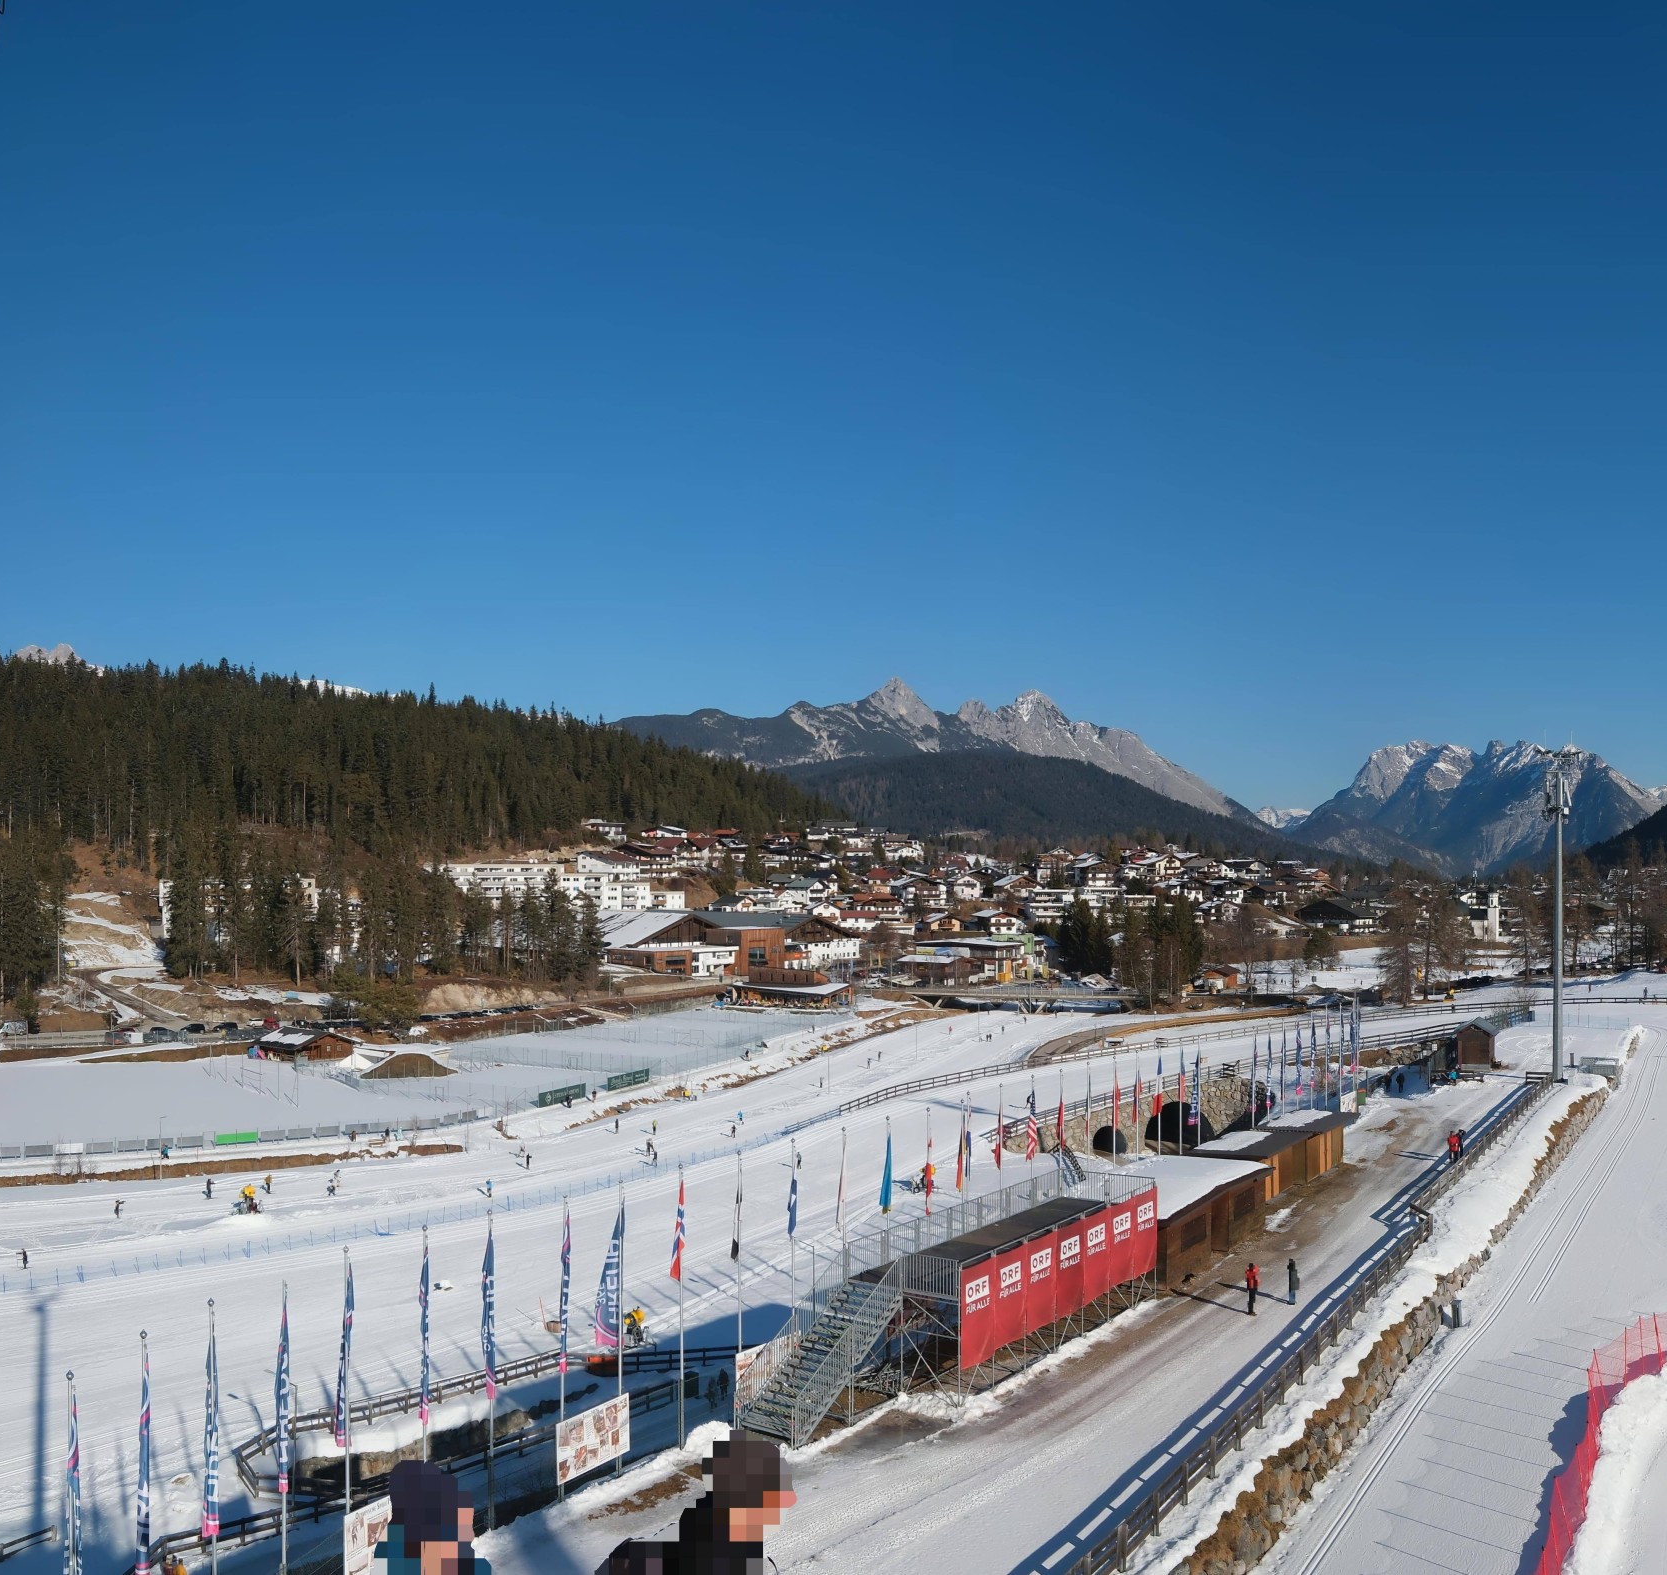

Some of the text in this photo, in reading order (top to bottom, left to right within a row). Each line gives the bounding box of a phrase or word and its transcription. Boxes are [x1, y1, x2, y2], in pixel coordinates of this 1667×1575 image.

[1138, 1204, 1152, 1219] ORF
[1114, 1215, 1129, 1231] ORF
[1088, 1227, 1104, 1243] ORF
[1062, 1239, 1078, 1255] ORF
[1032, 1252, 1050, 1269] ORF
[1069, 1255, 1080, 1266] ALLE
[1001, 1265, 1019, 1283] ORF
[968, 1280, 987, 1298] ORF
[1008, 1282, 1022, 1295] ALLE
[966, 1297, 990, 1315] FÜR ALLE
